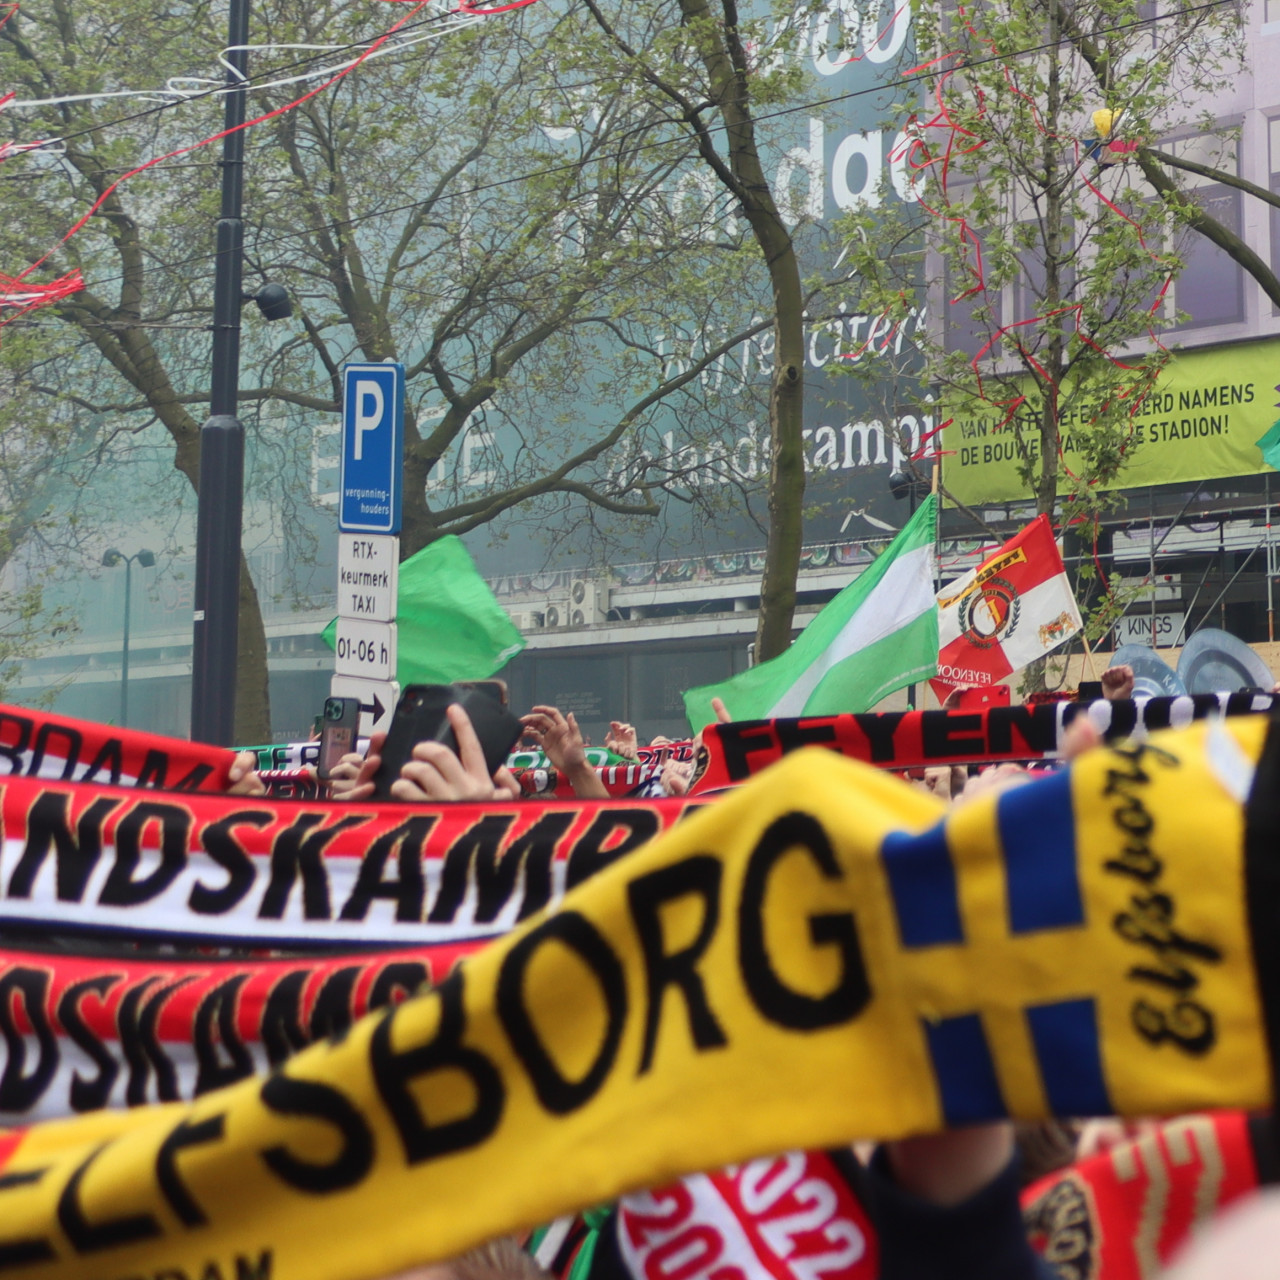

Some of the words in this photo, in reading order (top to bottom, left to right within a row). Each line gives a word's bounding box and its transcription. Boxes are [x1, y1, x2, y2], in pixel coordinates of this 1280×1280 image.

[354, 379, 385, 461] P
[960, 420, 988, 440] VAN
[1178, 382, 1256, 412] NAMENS
[960, 447, 980, 467] DE
[983, 438, 1044, 464] BOUWE
[1149, 414, 1230, 443] STADION!
[345, 487, 390, 511] vergunning-
[360, 500, 390, 516] houders
[352, 540, 378, 562] RTX-
[340, 569, 389, 589] keurmerk
[351, 593, 376, 615] TAXI
[1128, 615, 1173, 636] KINGS
[337, 636, 376, 665] 01-06
[380, 644, 389, 666] h
